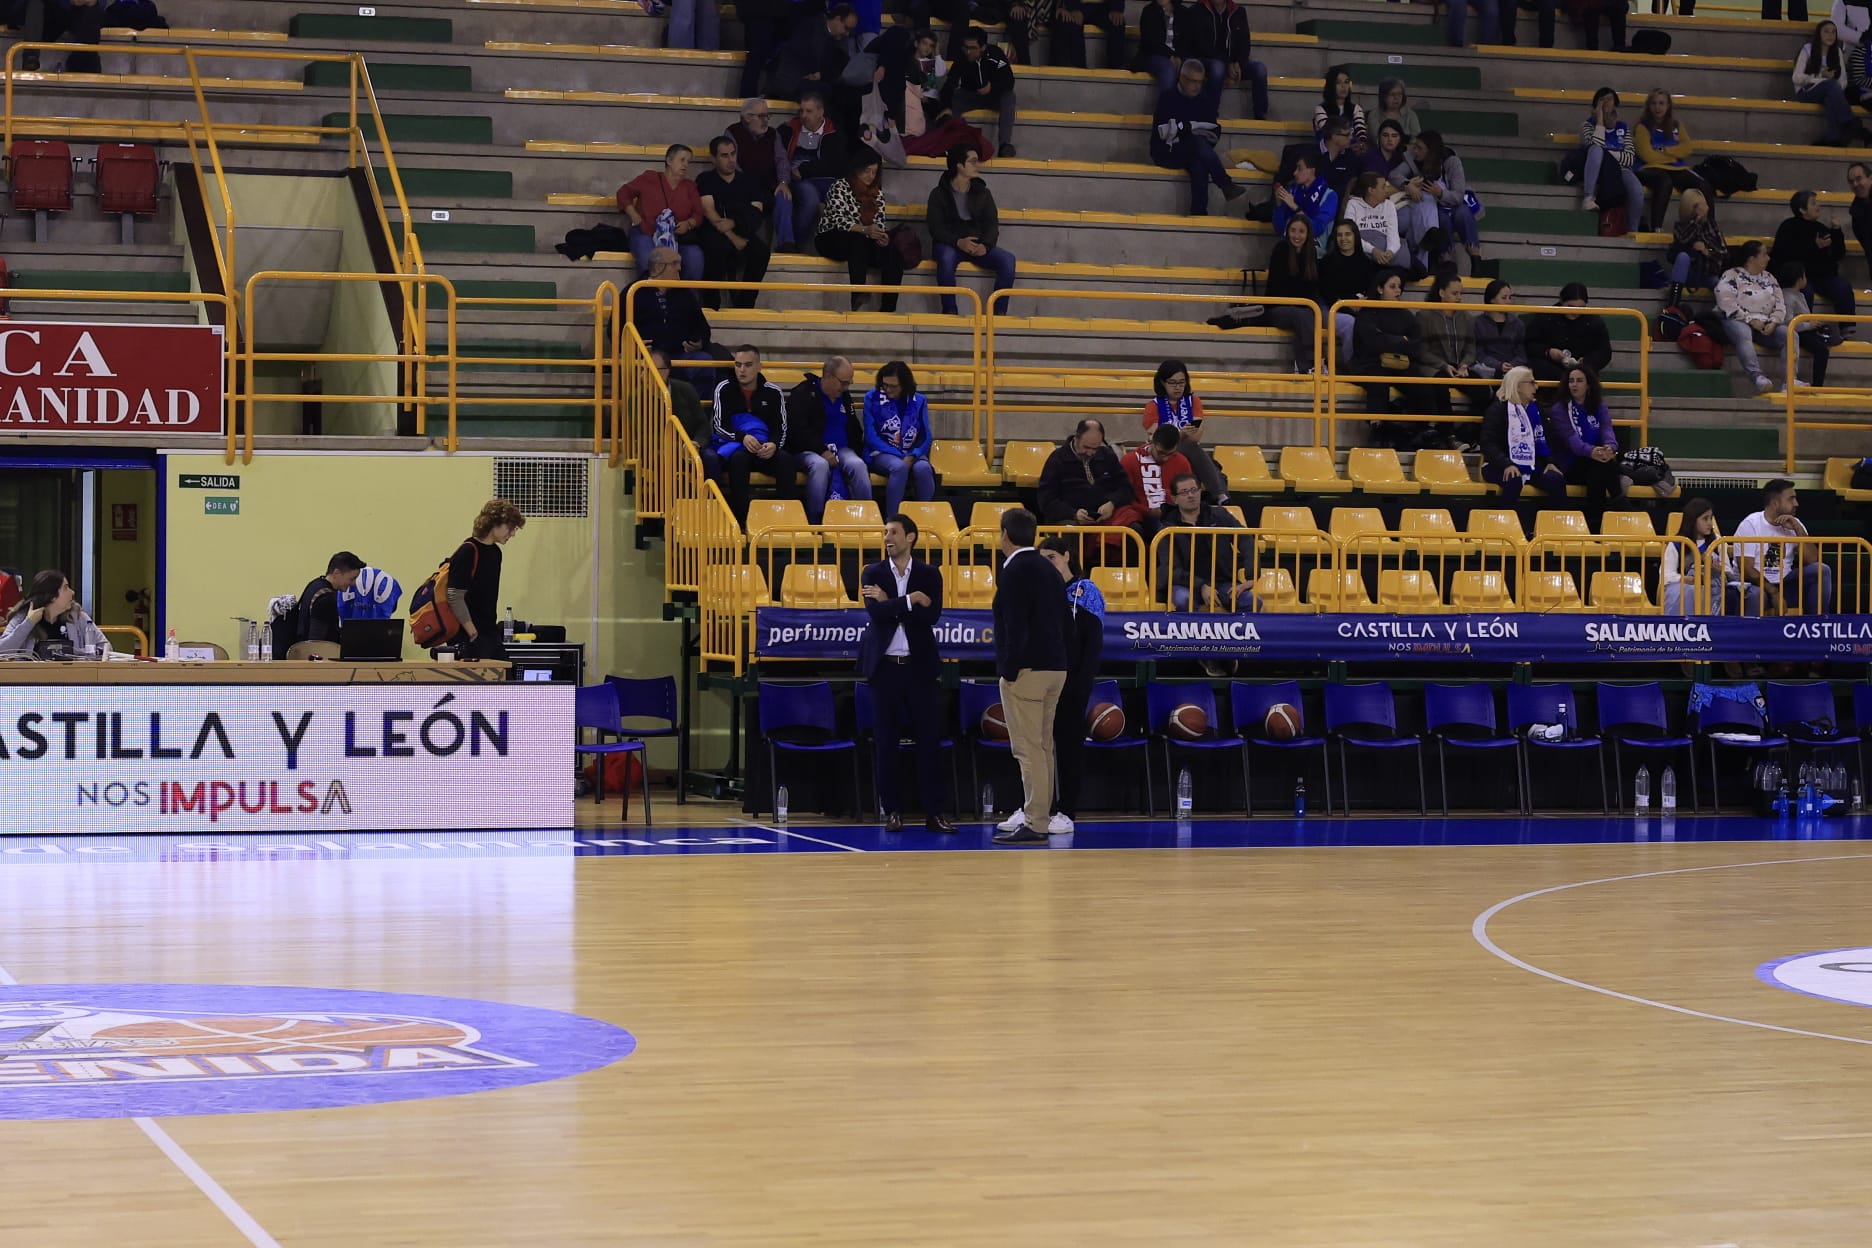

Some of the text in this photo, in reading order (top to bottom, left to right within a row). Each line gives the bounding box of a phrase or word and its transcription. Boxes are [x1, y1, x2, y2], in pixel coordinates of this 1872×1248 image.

[0, 386, 200, 424] ANIDAD
[200, 476, 235, 488] SALIDA
[212, 502, 227, 510] DEA
[768, 622, 870, 647] perfumer
[1123, 621, 1261, 640] SALAMANCA
[1337, 616, 1519, 641] CASTILLA Y LEÓN
[1585, 622, 1712, 642] SALAMANCA
[1159, 644, 1199, 652] Patrimonio
[1200, 644, 1210, 652] de
[1220, 644, 1260, 653] Humanidad
[1388, 642, 1412, 652] NOS
[1830, 643, 1852, 652] NOS
[0, 692, 509, 769] STILLA Y LEÓN
[78, 780, 352, 822] NOS IMPULSA
